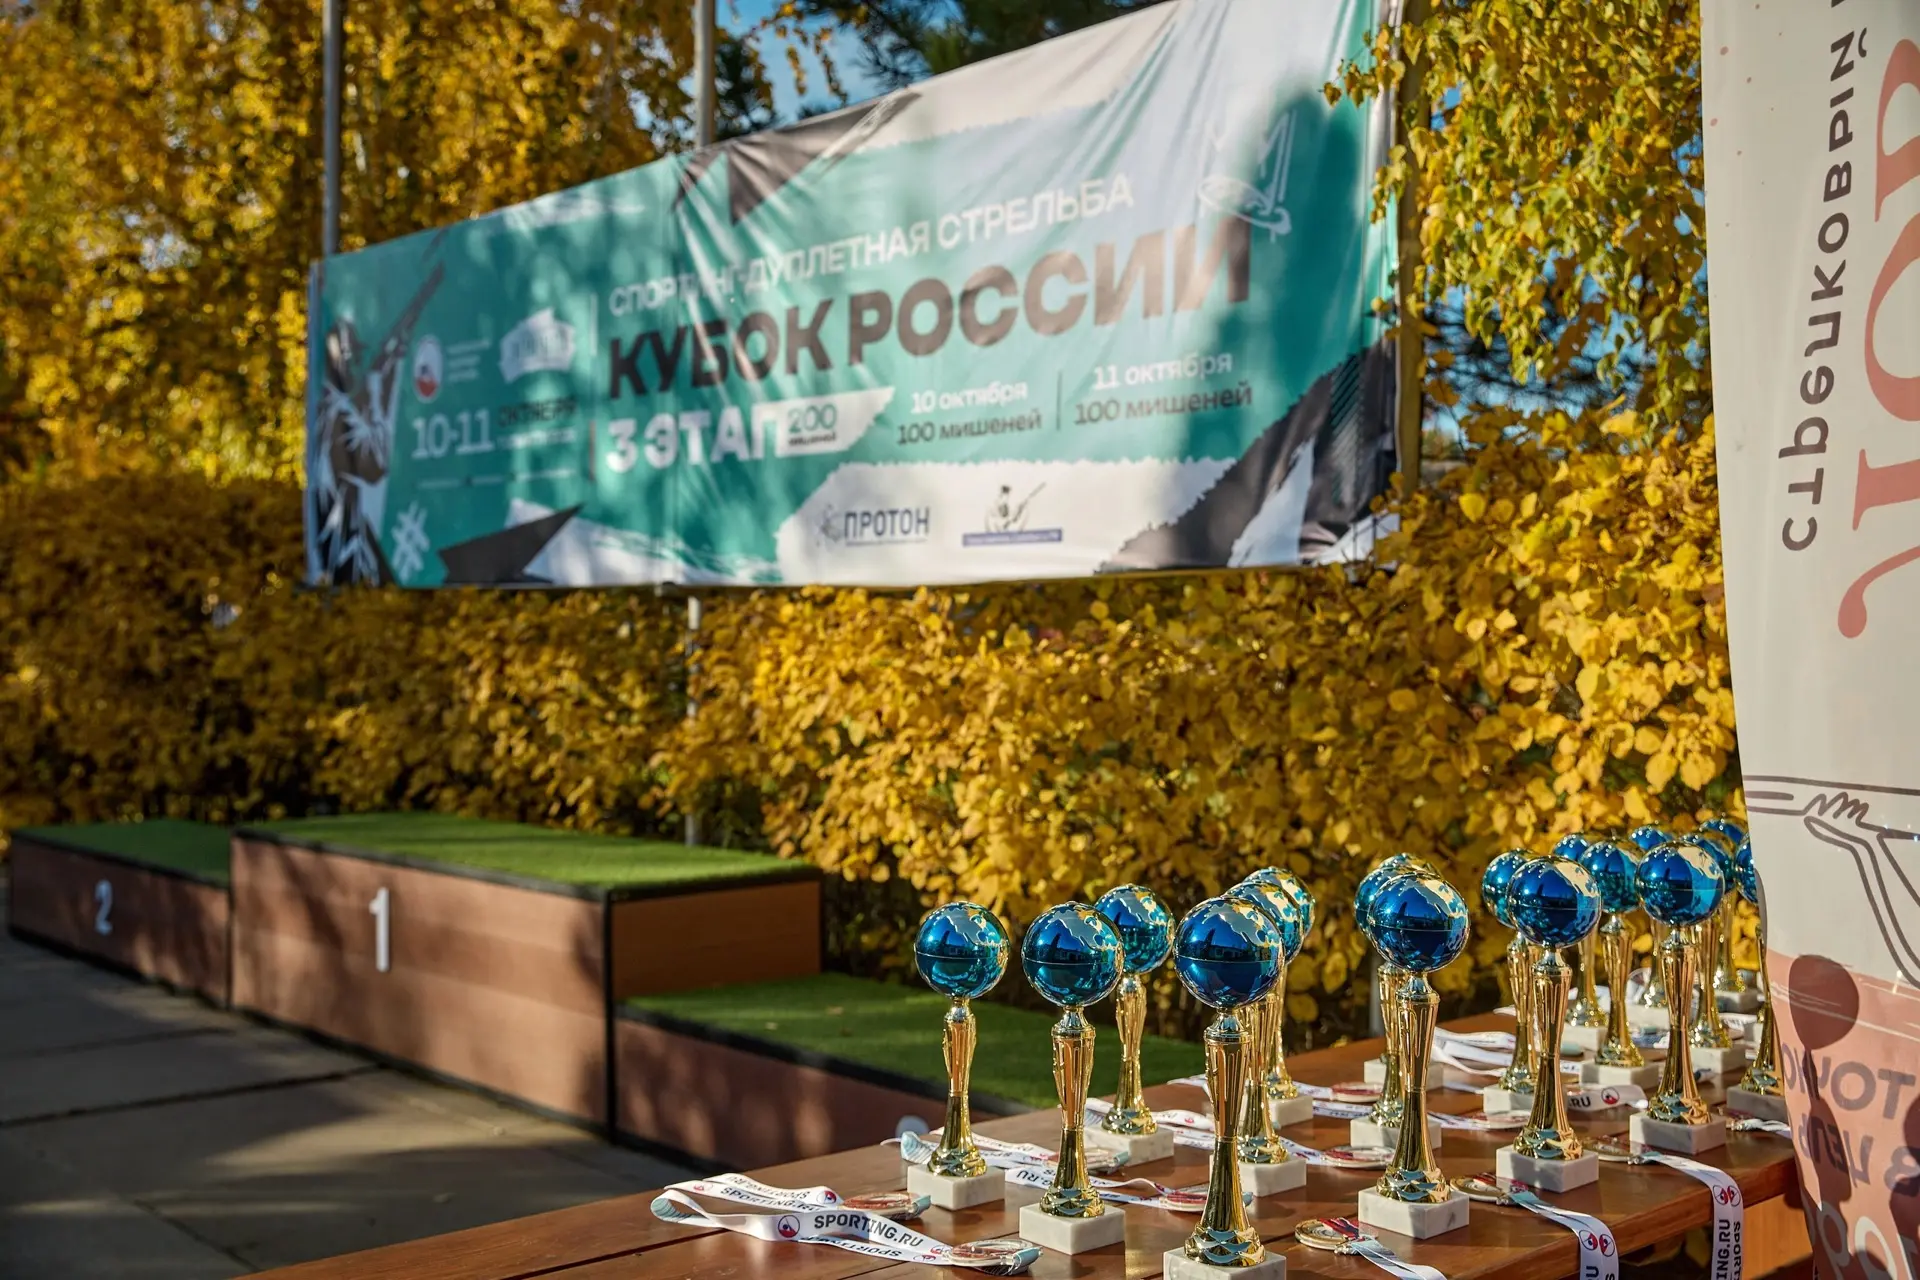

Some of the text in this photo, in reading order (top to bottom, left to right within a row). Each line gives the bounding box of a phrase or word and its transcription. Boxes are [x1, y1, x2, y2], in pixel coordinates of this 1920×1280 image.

[937, 173, 1134, 249] СТРЕЛЬБА
[609, 213, 1251, 401] КУБОК РОССИИ
[1092, 352, 1233, 391] 11 октября
[788, 403, 837, 434] 200
[910, 380, 1029, 415] 10 октября
[1074, 380, 1253, 426] 100 мишеней
[606, 402, 788, 473] 3 ЭТАП
[897, 408, 1042, 445] 100 мишеней
[844, 507, 930, 538] ПРОТОН
[95, 879, 113, 935] 2
[369, 887, 390, 972] 1
[814, 1213, 924, 1247] SPORTING.RU
